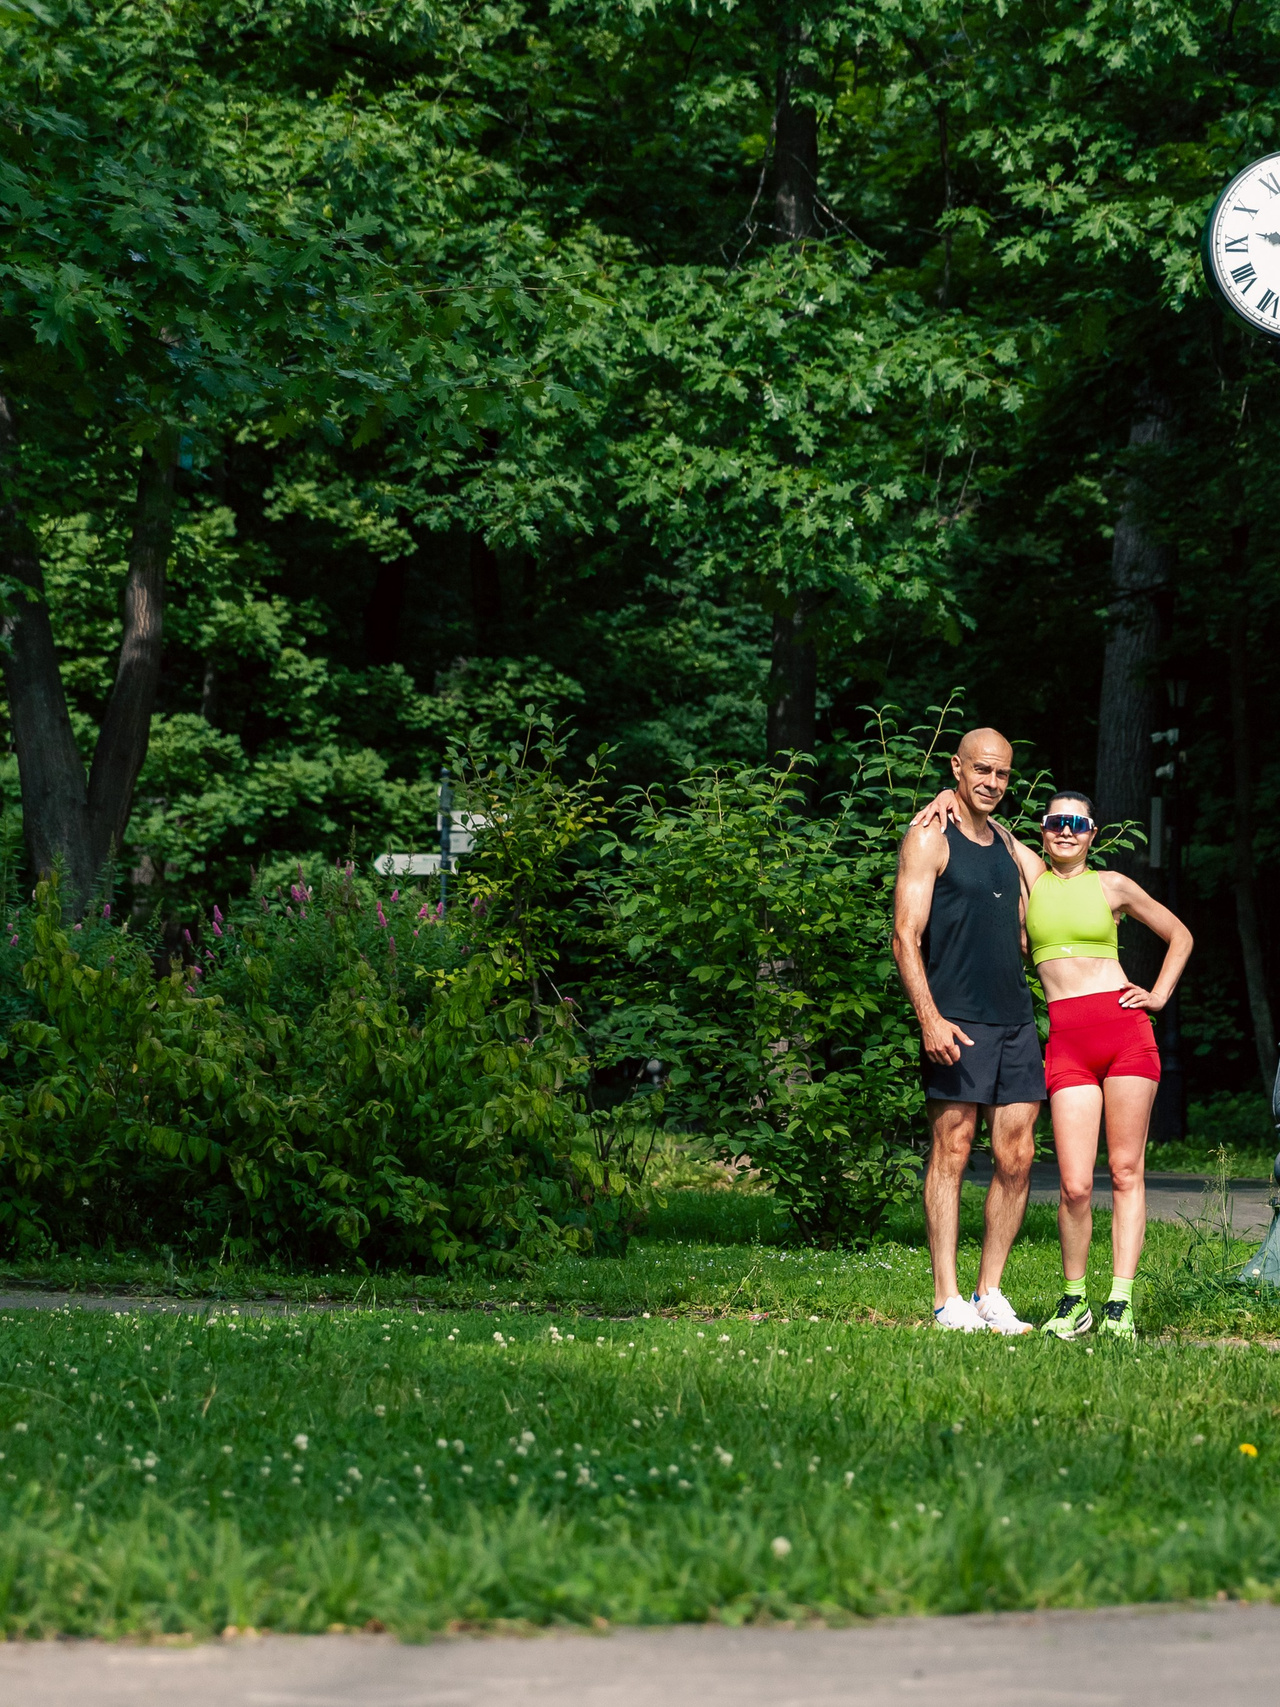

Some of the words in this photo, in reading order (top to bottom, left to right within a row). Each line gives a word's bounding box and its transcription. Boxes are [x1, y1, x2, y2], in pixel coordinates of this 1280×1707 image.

[1232, 199, 1260, 220] X
[1225, 234, 1249, 253] IX
[1230, 261, 1258, 296] VIII
[1255, 288, 1280, 320] VII
